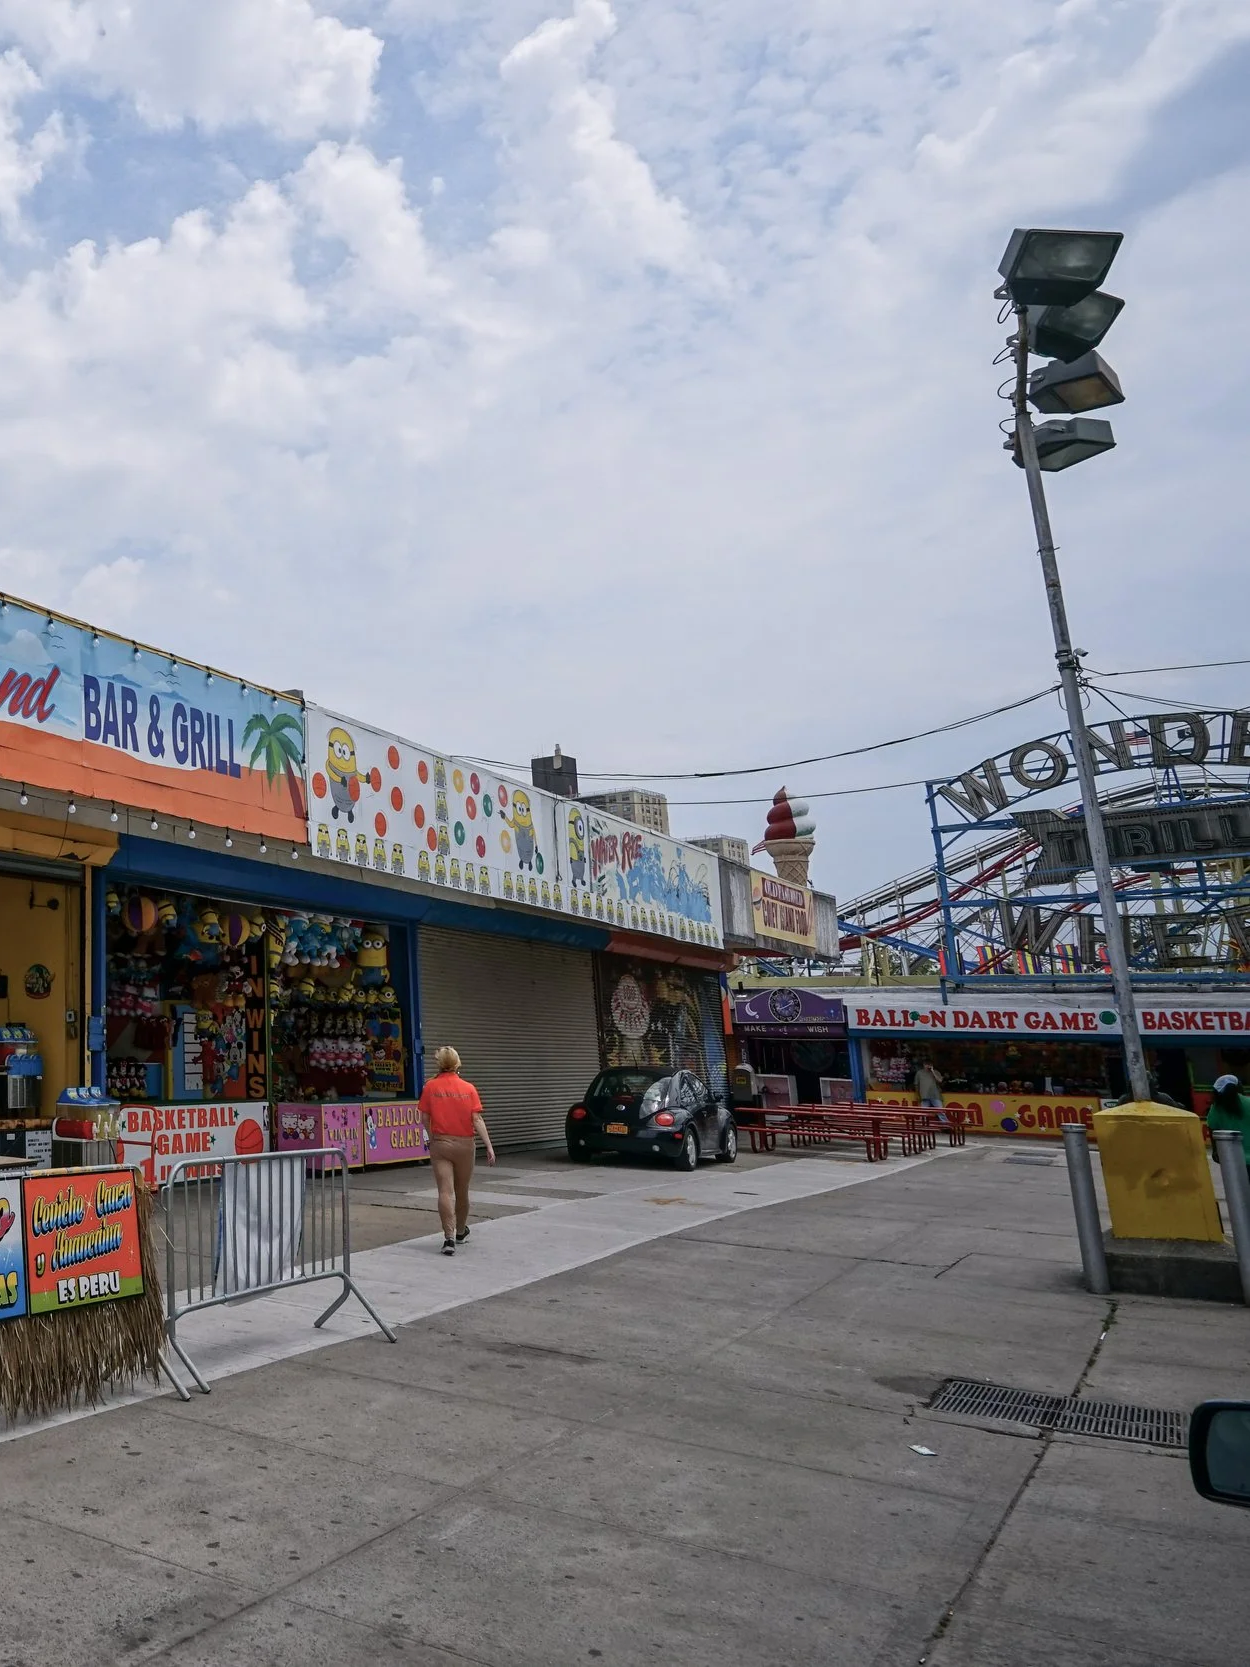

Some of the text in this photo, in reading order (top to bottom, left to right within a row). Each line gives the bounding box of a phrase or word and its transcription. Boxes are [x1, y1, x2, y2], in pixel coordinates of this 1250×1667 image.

[83, 673, 242, 779] BAR & GRILL
[744, 1025, 767, 1033] MAKE
[807, 1025, 829, 1033] WISH
[953, 1010, 1019, 1030] DART
[1024, 1010, 1098, 1031] GAME
[246, 1008, 265, 1099] WINS
[127, 1107, 236, 1133] BASKETBALL
[377, 1107, 422, 1129] BALLOO
[1017, 1103, 1095, 1131] GAME
[157, 1131, 211, 1156] GAME
[328, 1127, 359, 1141] WIN WIN
[390, 1127, 421, 1148] GAME
[140, 1158, 157, 1183] 1
[32, 1179, 133, 1238] Ceviche Causa
[36, 1252, 46, 1277] y
[57, 1270, 120, 1304] ES PERU
